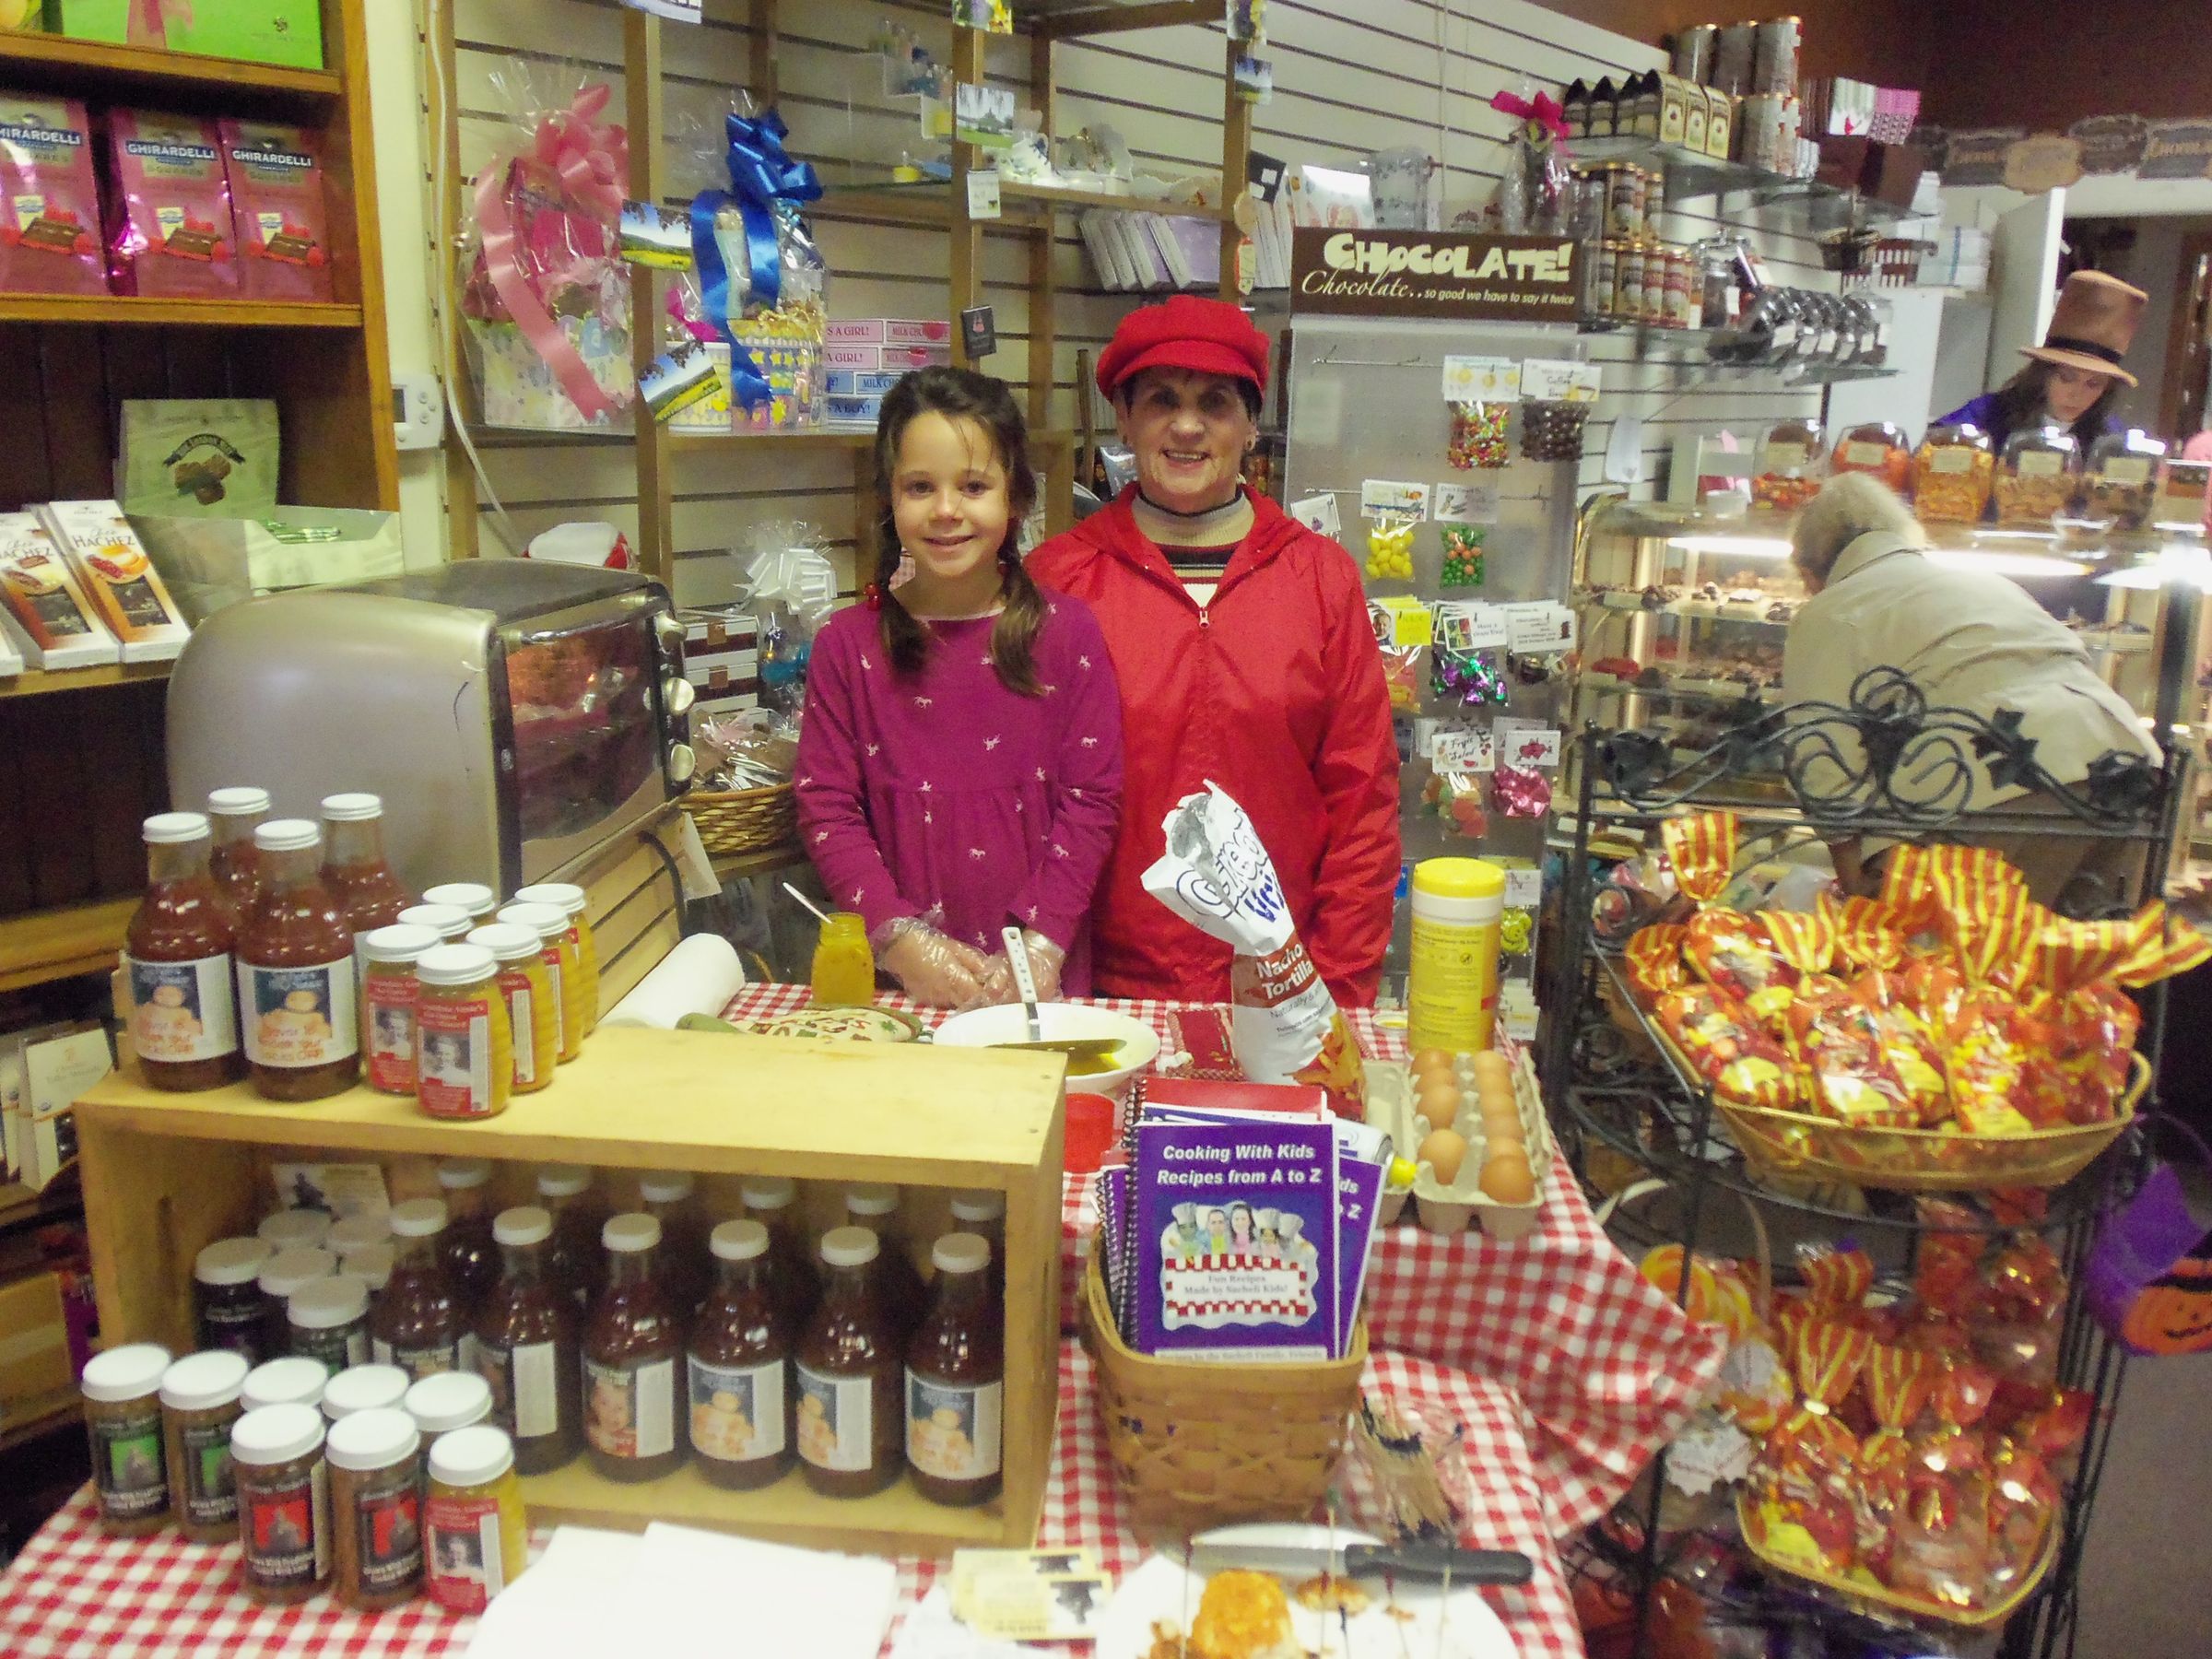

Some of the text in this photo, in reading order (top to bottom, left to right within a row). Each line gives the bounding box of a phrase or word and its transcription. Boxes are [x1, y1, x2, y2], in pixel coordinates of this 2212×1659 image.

[0, 127, 81, 145] HIRARDELLI
[127, 142, 215, 159] GHIRARDELLI
[232, 150, 312, 167] GHIRARDELLI
[1324, 233, 1573, 282] CHOCOLATE!
[1424, 288, 1436, 298] so
[1439, 288, 1465, 300] good
[1466, 291, 1481, 300] we
[1484, 289, 1508, 301] have
[1510, 291, 1521, 302] to
[1523, 294, 1539, 305] say
[1541, 294, 1548, 303] it
[1550, 294, 1575, 304] twice
[843, 326, 869, 335] GIRL!
[835, 353, 863, 362] GIRL!
[863, 378, 882, 388] MILK
[0, 547, 53, 559] ACHEZ
[1256, 944, 1302, 978] Nacho
[1262, 960, 1314, 999] Tortilla
[1163, 1143, 1315, 1163] Cooking With Kids
[1157, 1167, 1323, 1187] Recipes from A to Z
[1347, 1202, 1363, 1220] Z
